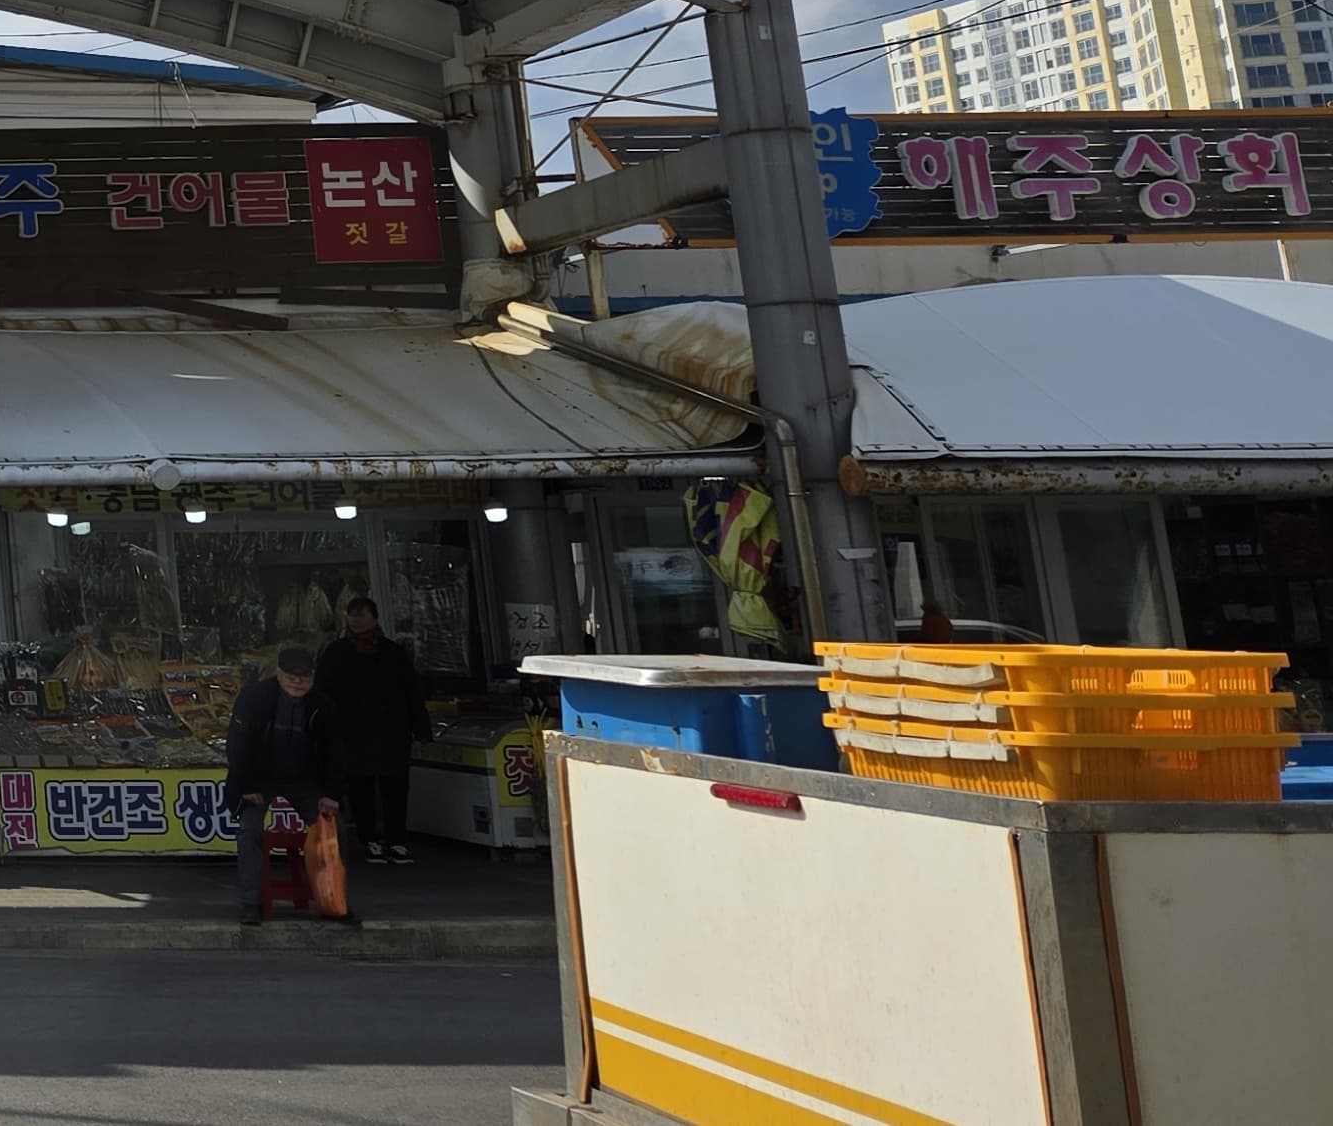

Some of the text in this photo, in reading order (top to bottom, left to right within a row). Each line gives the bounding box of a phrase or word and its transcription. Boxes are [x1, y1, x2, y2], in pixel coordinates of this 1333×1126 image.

[106, 169, 291, 231] 건어물
[320, 159, 419, 211] 논산
[897, 131, 1312, 222] 해주상회
[46, 780, 168, 841] 반건조
